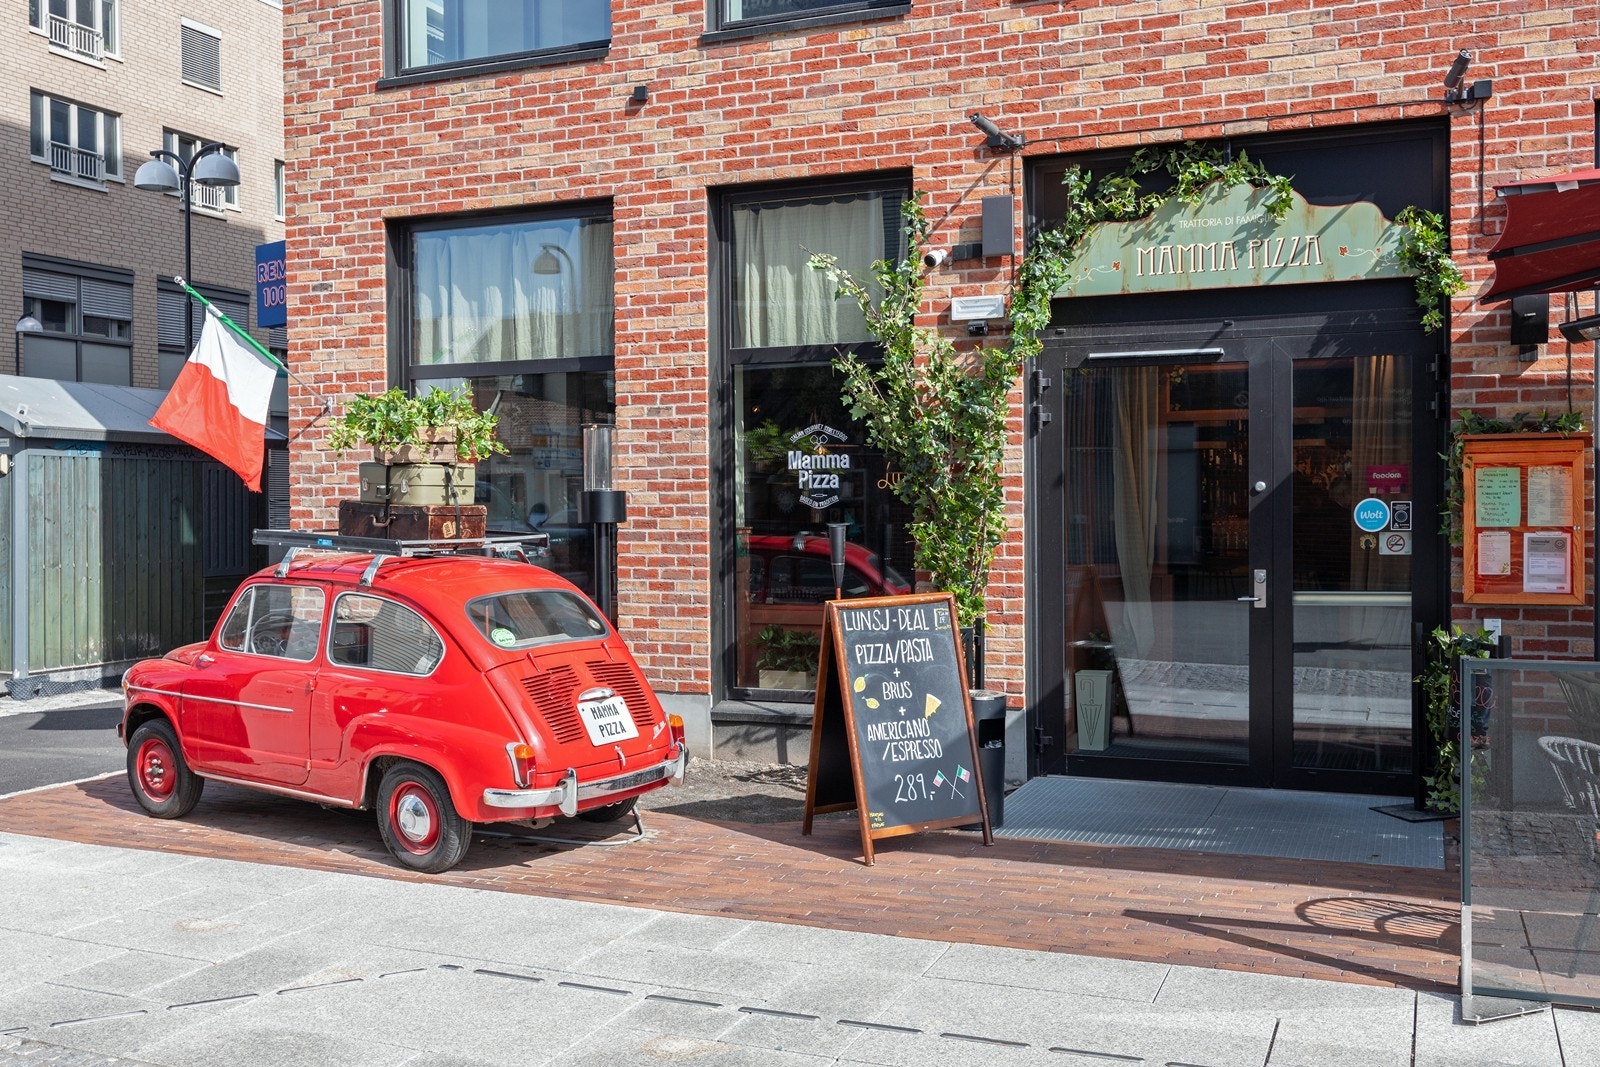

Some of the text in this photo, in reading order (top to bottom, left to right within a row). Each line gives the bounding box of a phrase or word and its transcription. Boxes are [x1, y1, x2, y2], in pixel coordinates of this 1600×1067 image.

[1179, 217, 1223, 229] TRATTORIA
[1225, 216, 1234, 226] DI
[1136, 235, 1324, 277] MAMMA PIZZA
[788, 450, 850, 469] Mamma
[798, 470, 839, 489] Pizza
[1372, 472, 1402, 480] foodora
[1360, 510, 1384, 519] Wolt
[855, 637, 934, 665] PIZZA/PASTA
[882, 680, 913, 701] BRUS
[590, 703, 620, 720] MAMMA
[598, 720, 627, 738] PIZZA
[867, 717, 931, 742] AMERICANO
[882, 738, 943, 762] /ESPRESSO
